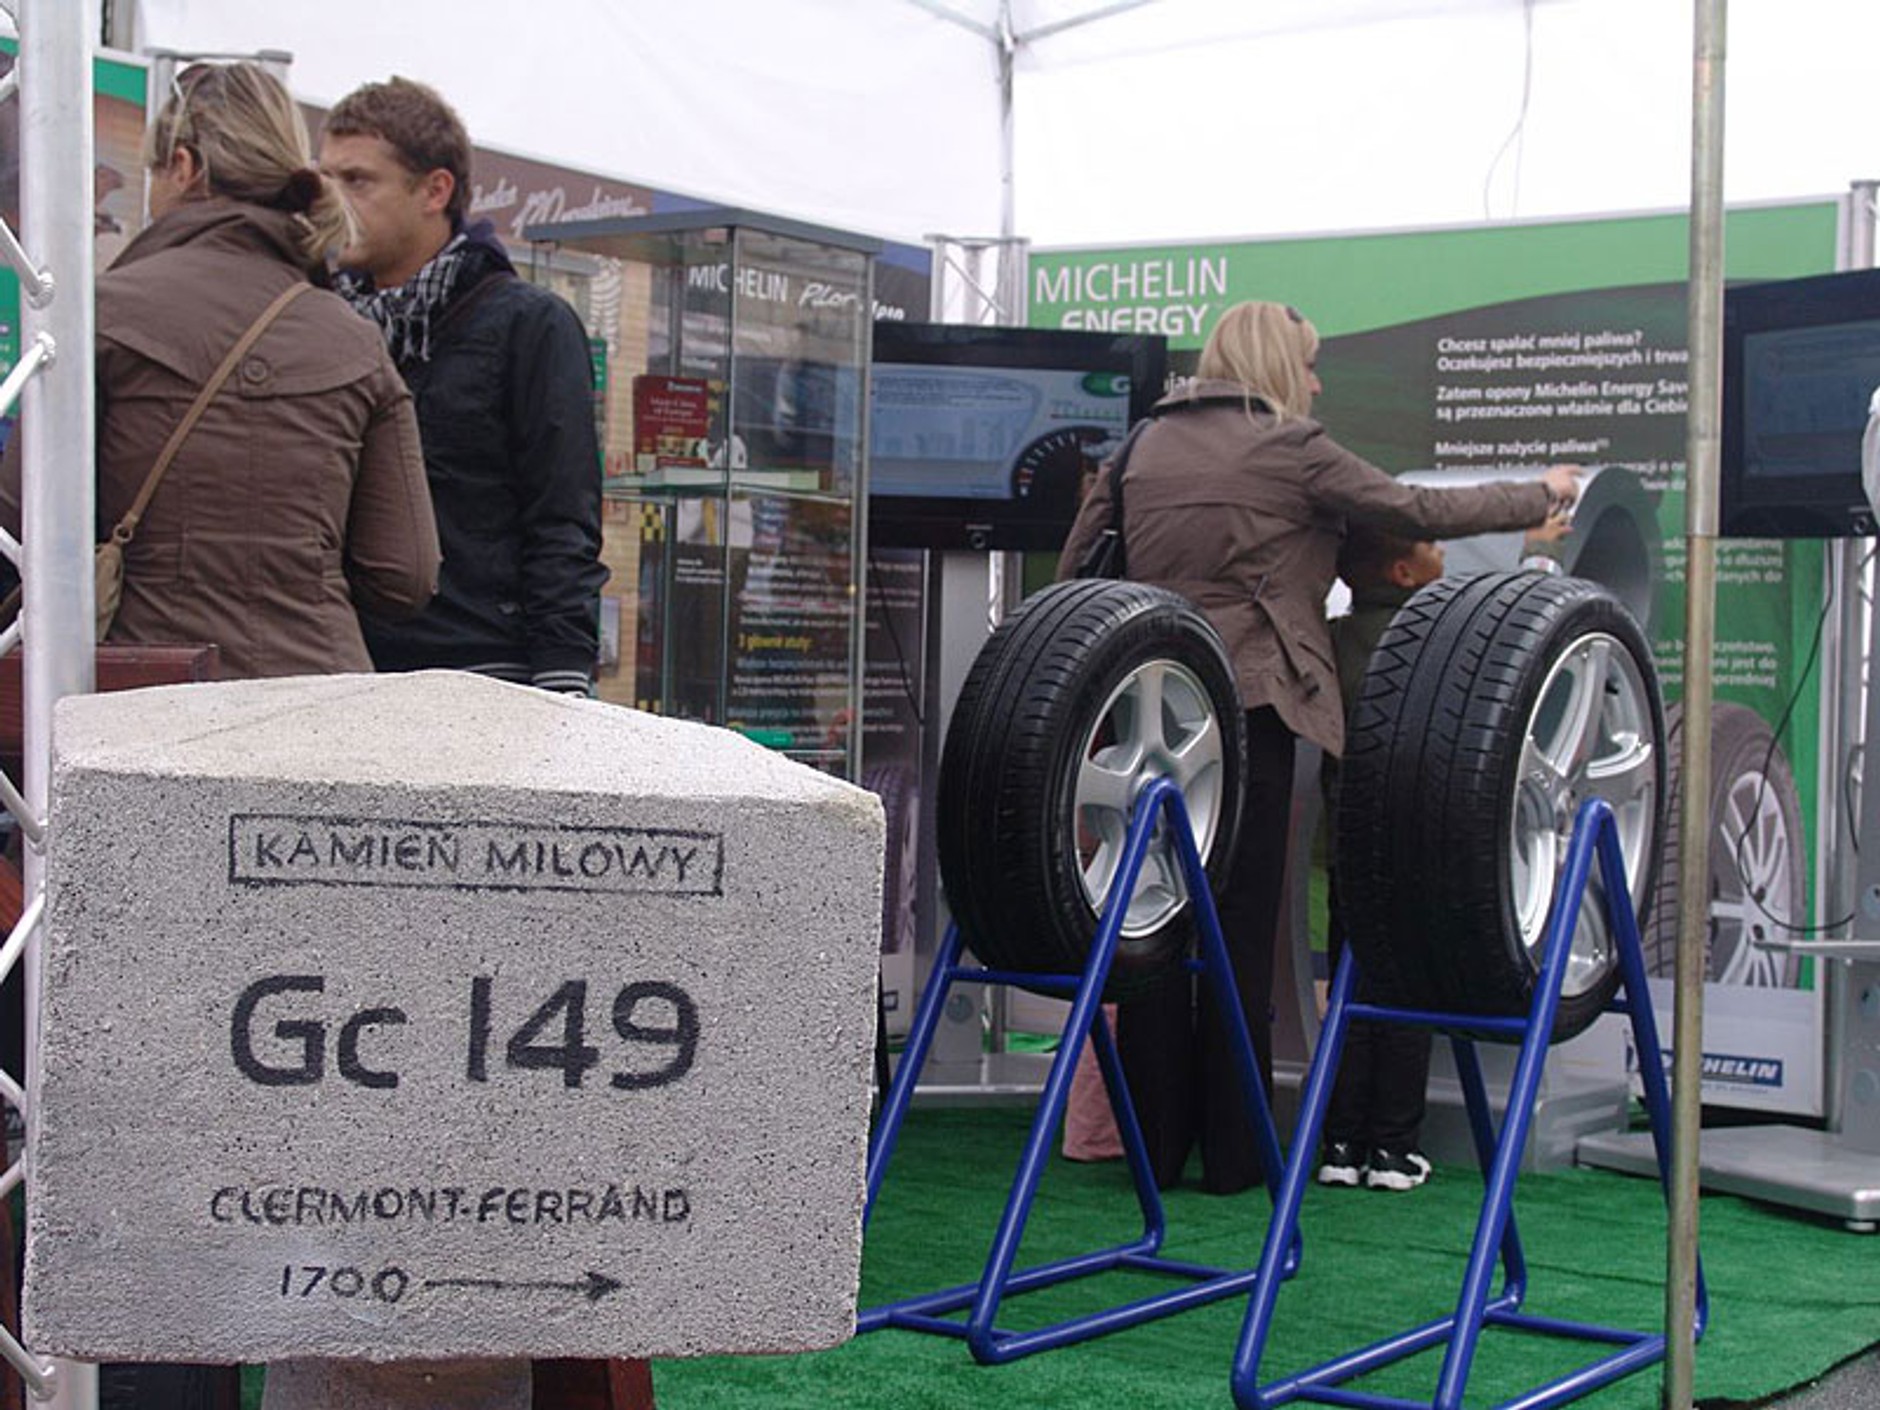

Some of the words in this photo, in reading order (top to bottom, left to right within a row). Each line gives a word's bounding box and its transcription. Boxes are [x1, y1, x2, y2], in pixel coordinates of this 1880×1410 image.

[688, 264, 789, 302] MICHELIN
[1036, 257, 1226, 303] MICHELIN
[1061, 303, 1209, 335] ENERGY
[1437, 337, 1486, 353] Chcesz
[1538, 332, 1581, 352] mniej
[1583, 329, 1644, 350] paliwa?
[1436, 354, 1513, 373] Oczekujesz
[1516, 349, 1642, 372] bezpieczniejszych
[1655, 350, 1689, 364] trwa
[1436, 386, 1482, 401] Zatem
[1485, 386, 1531, 403] opony
[1533, 381, 1598, 399] Michelin
[1601, 380, 1654, 399] Energy
[1455, 404, 1553, 422] przeznaczone
[1616, 399, 1641, 416] dla
[1434, 440, 1494, 459] Mniejsze
[485, 841, 698, 883] MILOWY
[230, 974, 407, 1090] Gc
[467, 975, 702, 1090] 149
[1702, 1058, 1779, 1080] HELIN
[210, 1186, 692, 1225] CLERMONT-FERRAND
[279, 1263, 410, 1302] 1700
